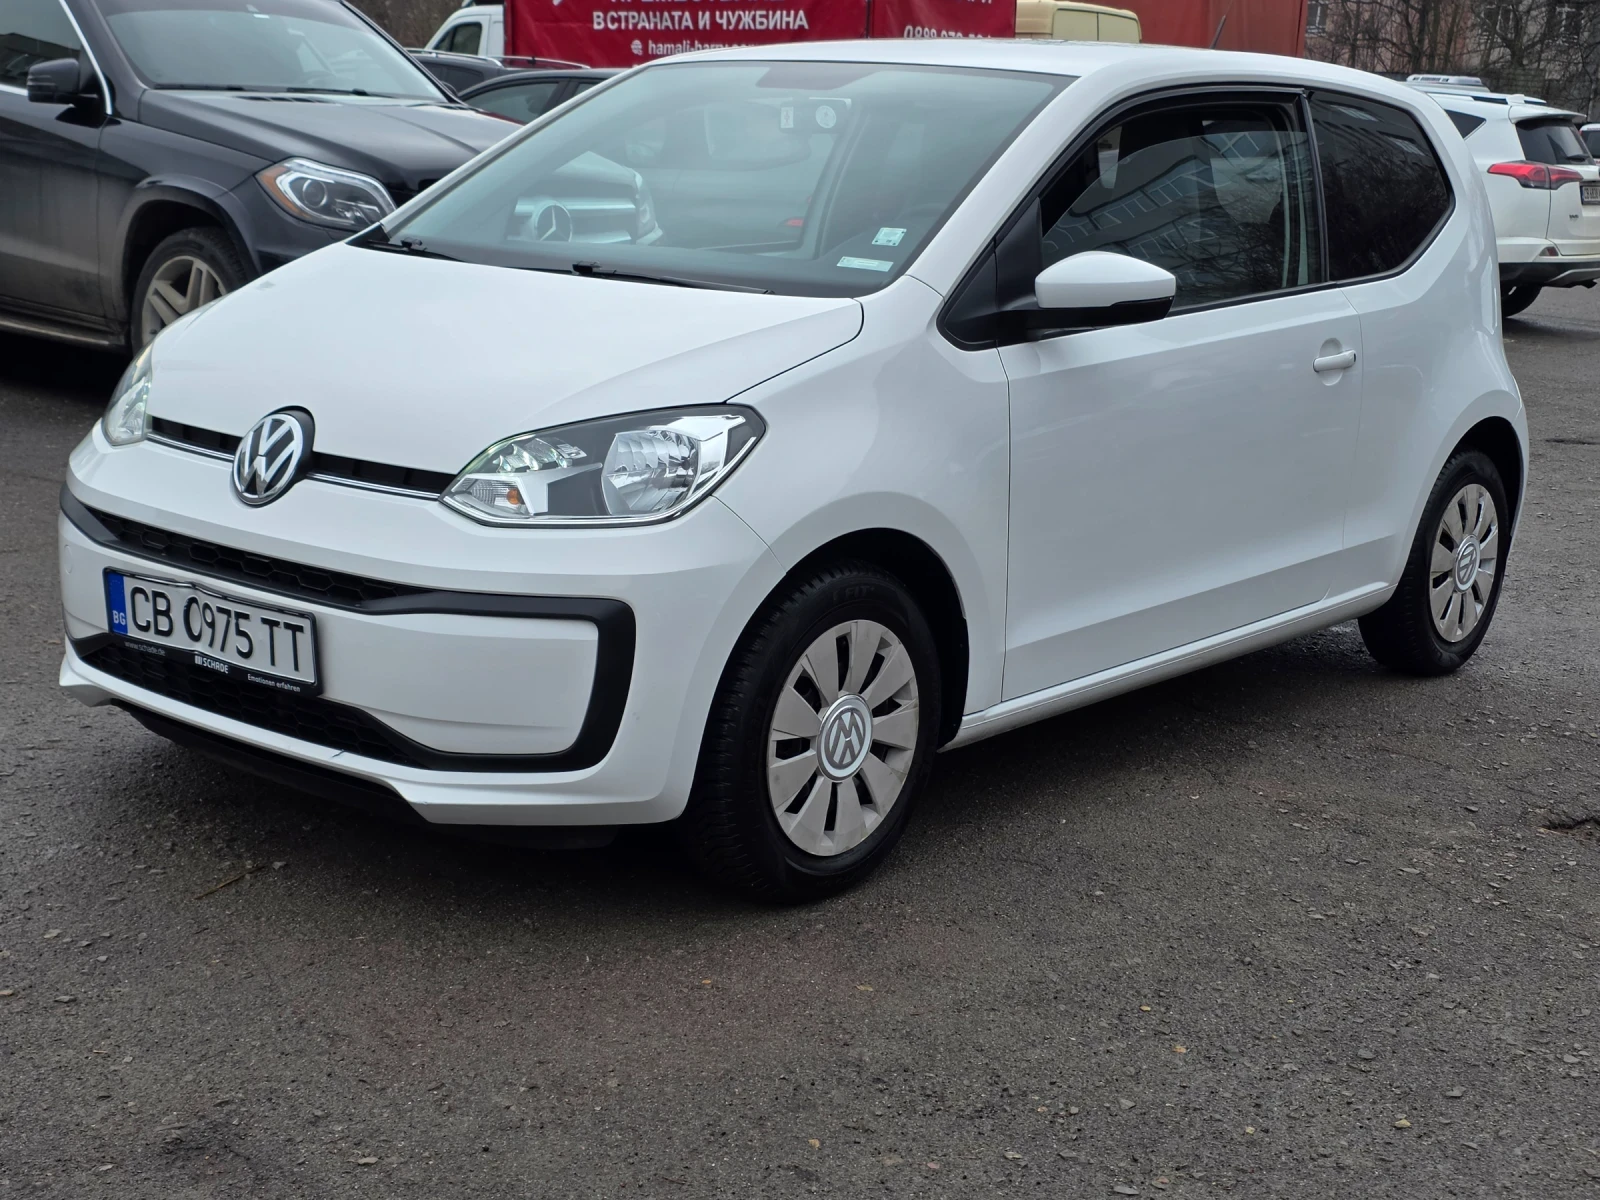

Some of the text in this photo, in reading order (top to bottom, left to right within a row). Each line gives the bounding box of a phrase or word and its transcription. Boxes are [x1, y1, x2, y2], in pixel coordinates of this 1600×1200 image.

[698, 10, 710, 30] И
[715, 10, 809, 30] ЧУЖБИНА
[112, 610, 127, 626] BG
[130, 586, 305, 672] CB 0975 TT
[124, 640, 166, 657] www.schade.de
[203, 657, 229, 674] SCHADE
[247, 673, 301, 693] Emotionen erfahren
